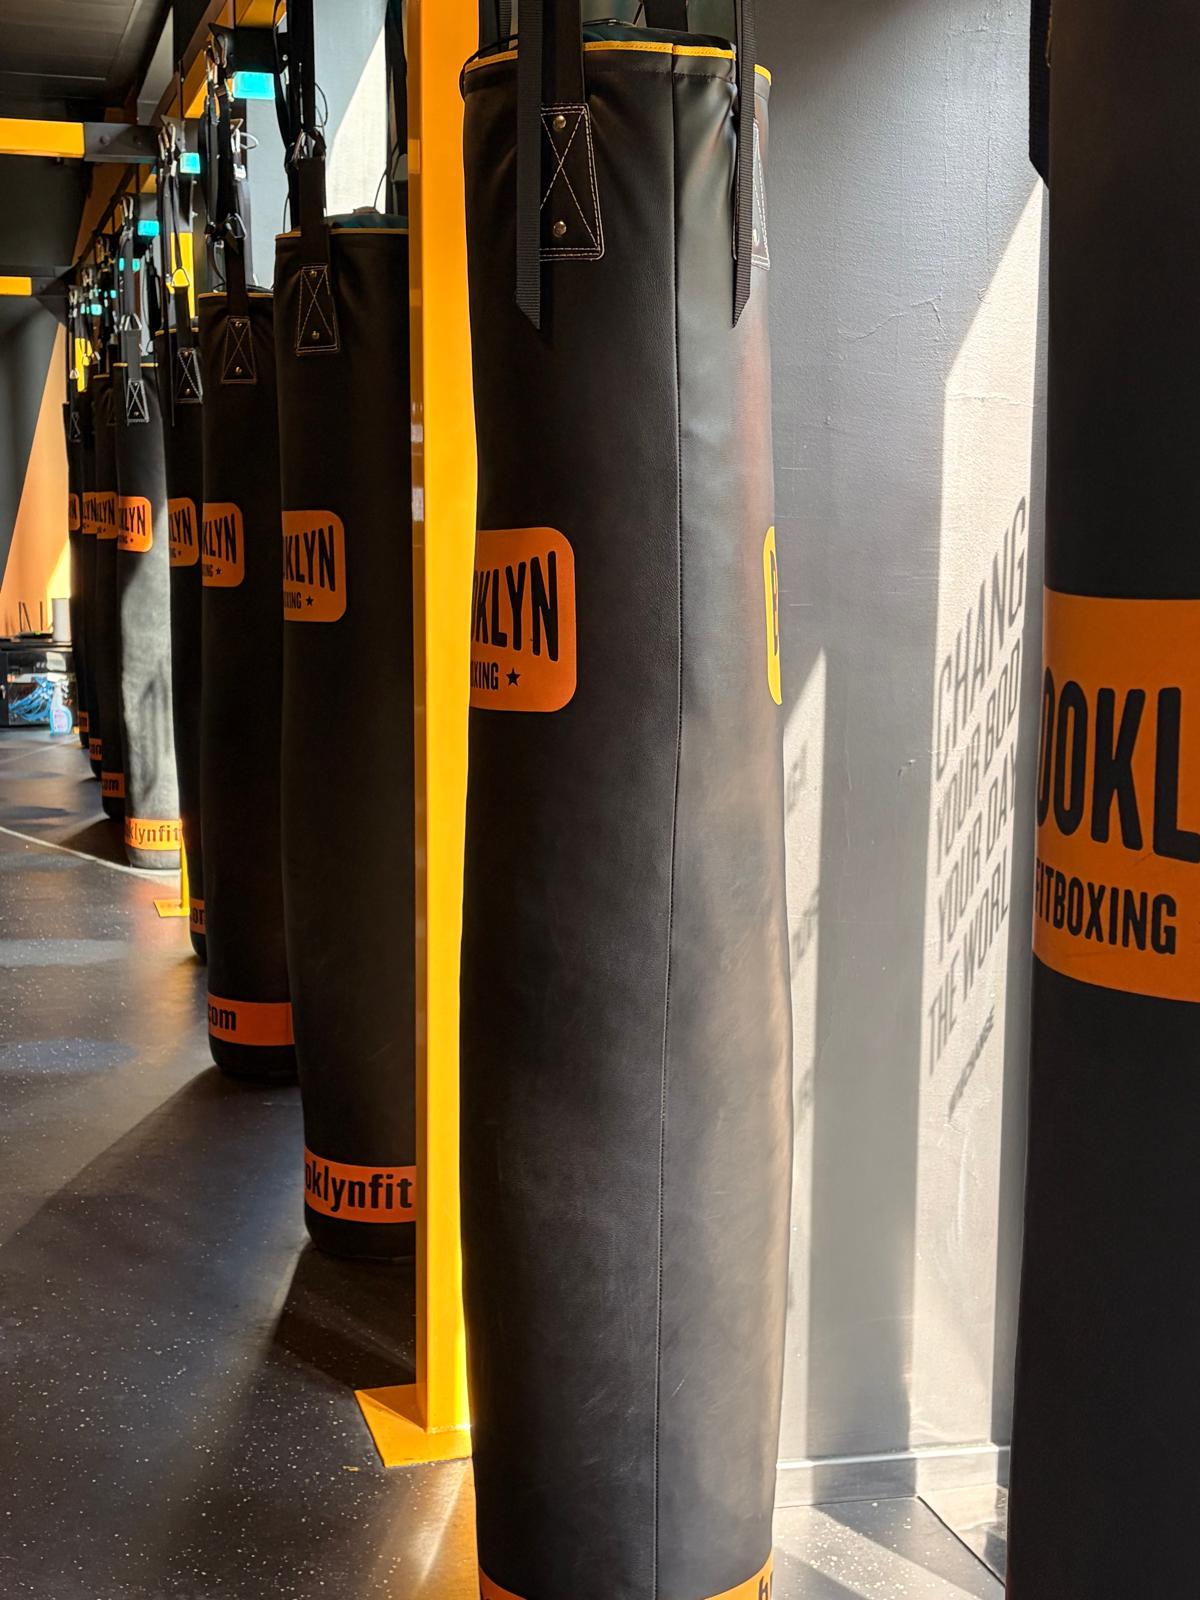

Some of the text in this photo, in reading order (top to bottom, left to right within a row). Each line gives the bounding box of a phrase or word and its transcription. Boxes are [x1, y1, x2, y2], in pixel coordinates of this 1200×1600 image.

[937, 496, 1026, 781] CHANG
[937, 722, 981, 877] YOUR
[938, 810, 982, 966] YOUR
[928, 948, 960, 1078] THE
